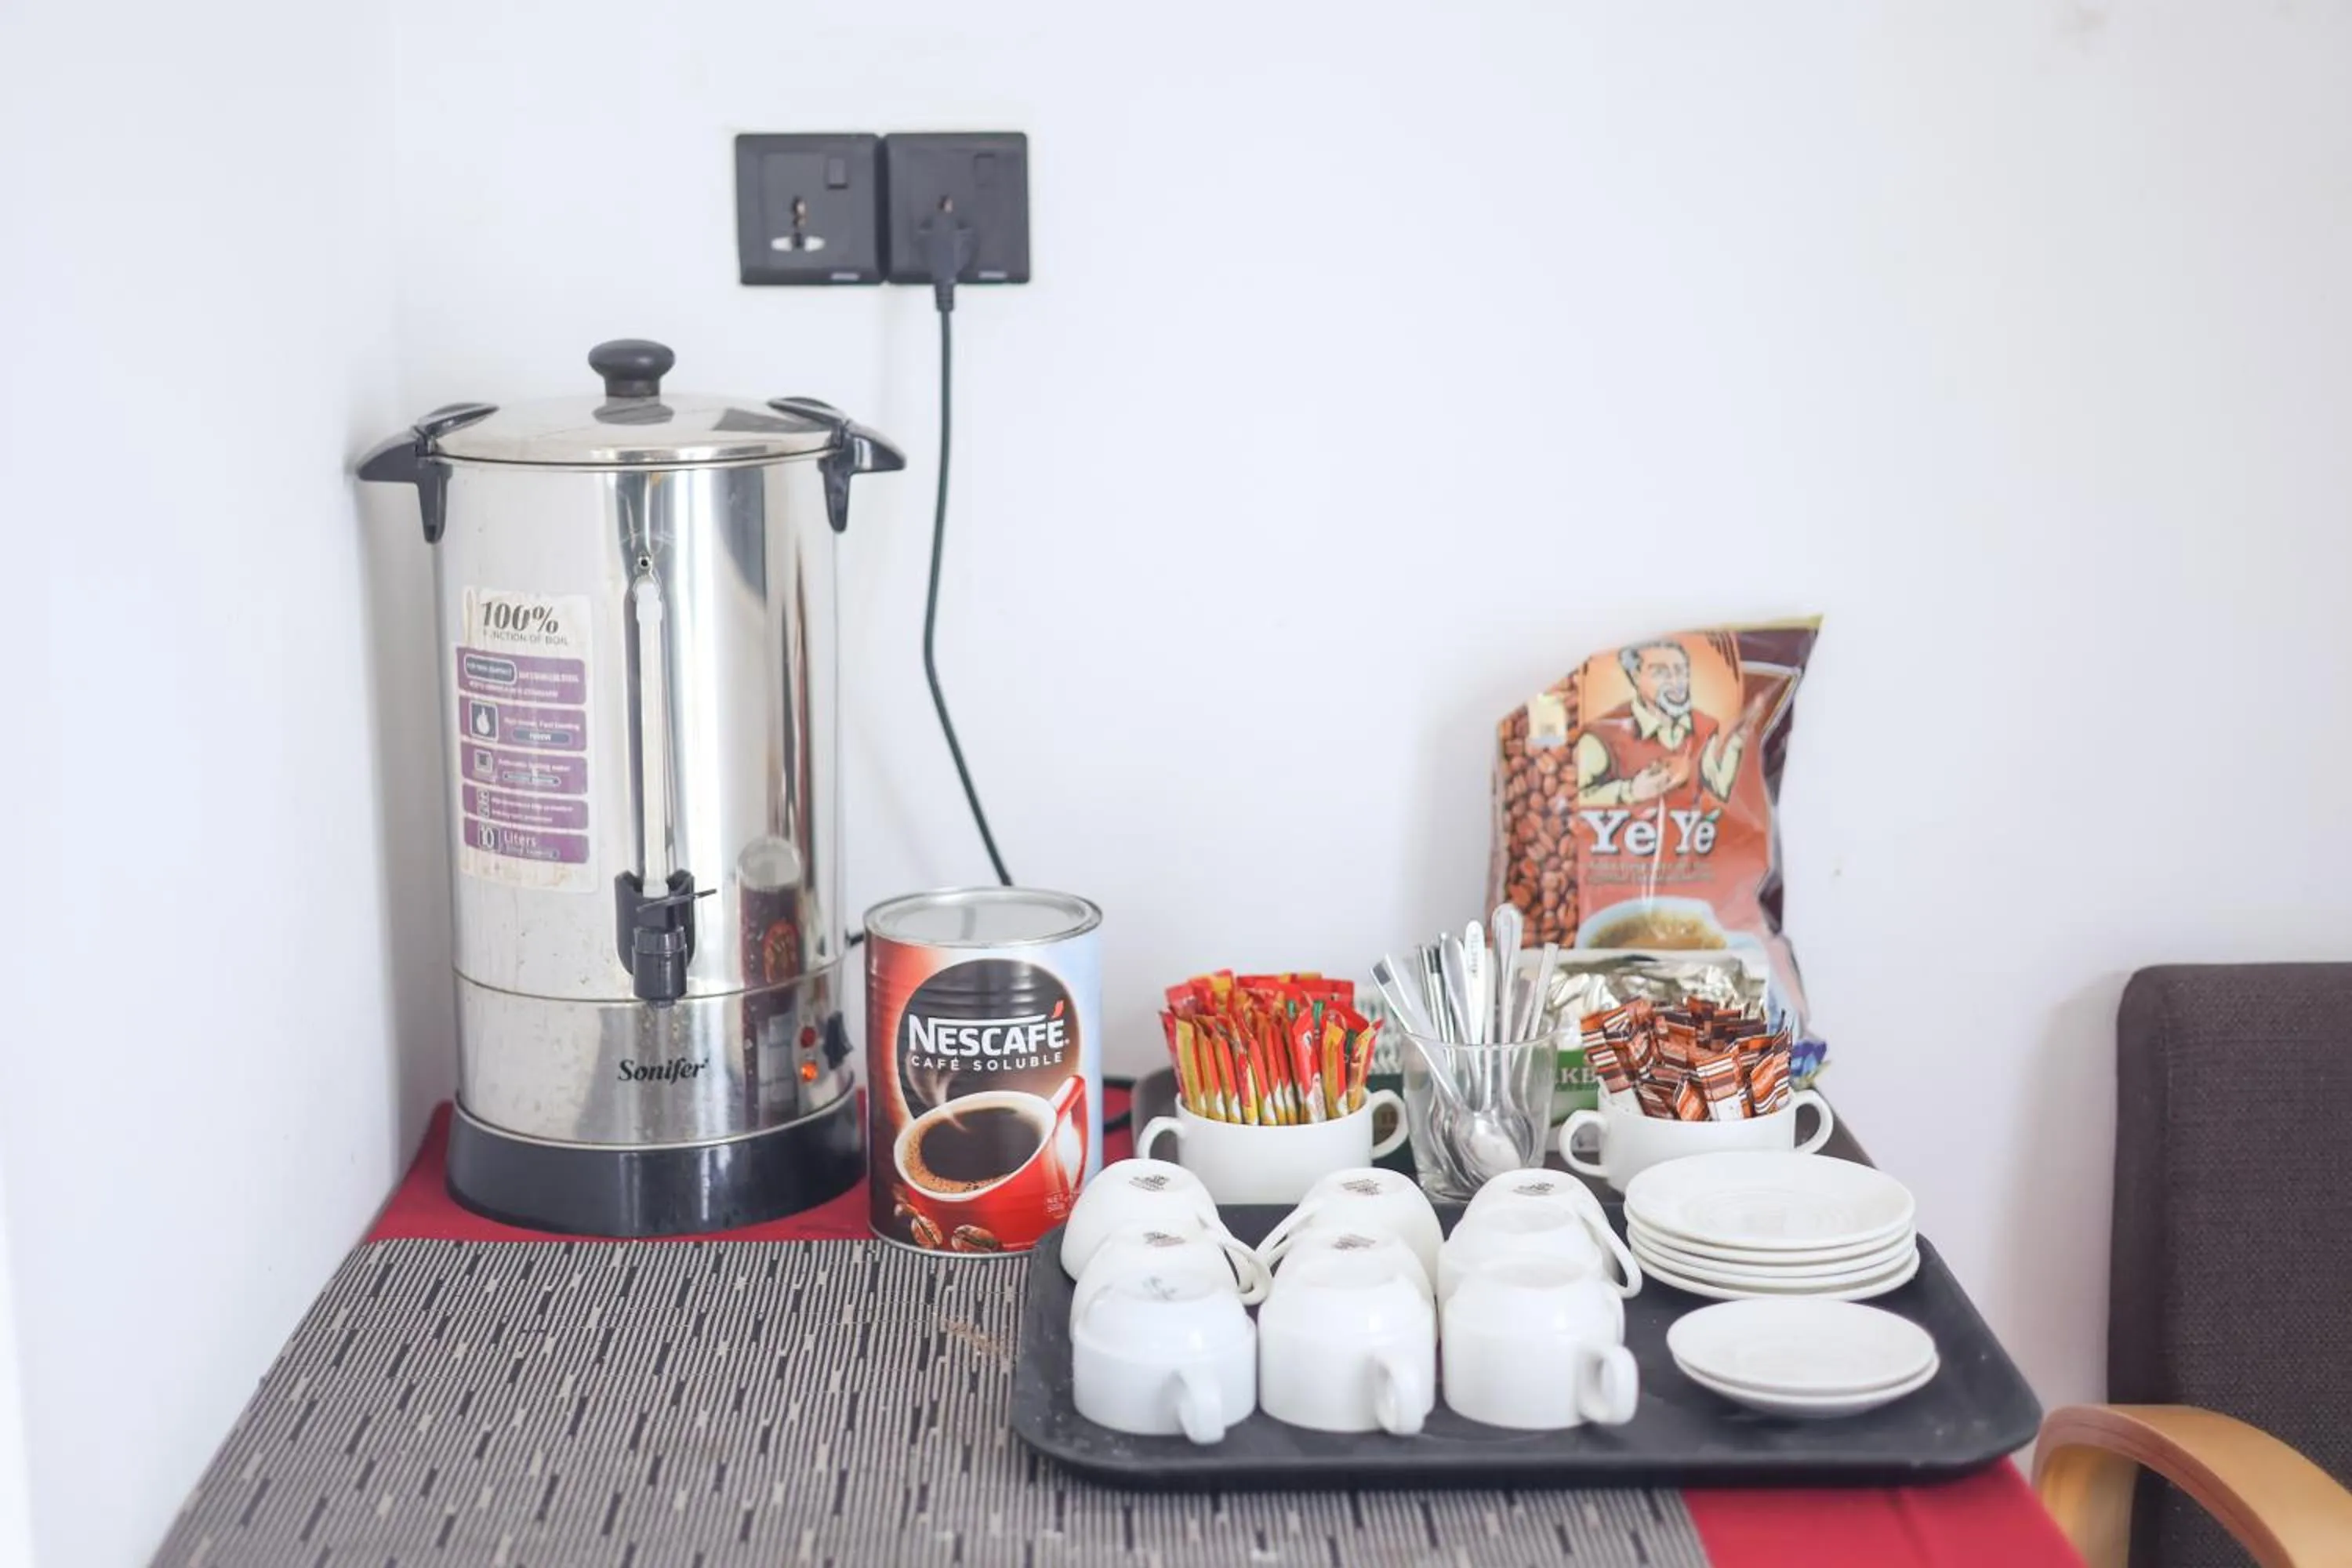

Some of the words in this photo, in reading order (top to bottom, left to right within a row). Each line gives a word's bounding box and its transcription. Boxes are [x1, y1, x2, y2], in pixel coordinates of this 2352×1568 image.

[481, 601, 559, 634] 100%
[1579, 808, 1658, 855] Yé
[1669, 808, 1722, 855] Yé
[908, 1000, 1065, 1057] NESCAFÉ
[617, 1057, 706, 1085] Sonifer
[911, 1055, 960, 1071] CAFÉ
[973, 1051, 1063, 1072] SOLUBLE
